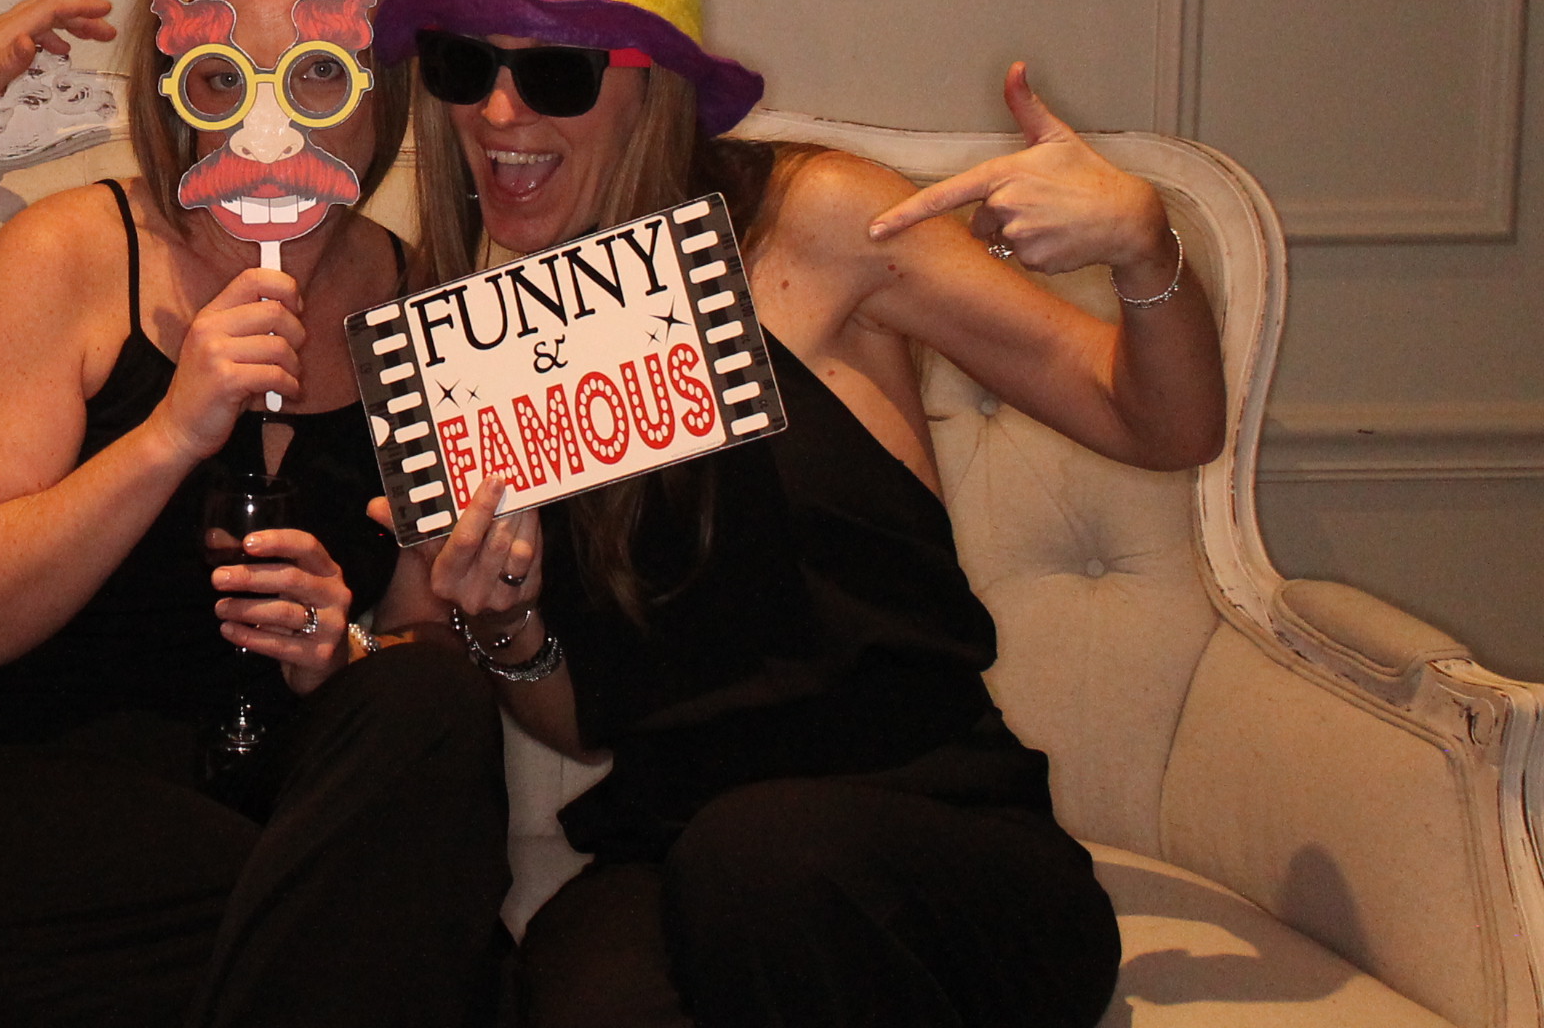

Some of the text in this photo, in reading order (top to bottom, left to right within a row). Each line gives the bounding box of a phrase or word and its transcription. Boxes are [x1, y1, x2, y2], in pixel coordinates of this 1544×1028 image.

[409, 219, 668, 368] FUNNY
[532, 334, 568, 374] &
[437, 343, 716, 510] FAMOUS
